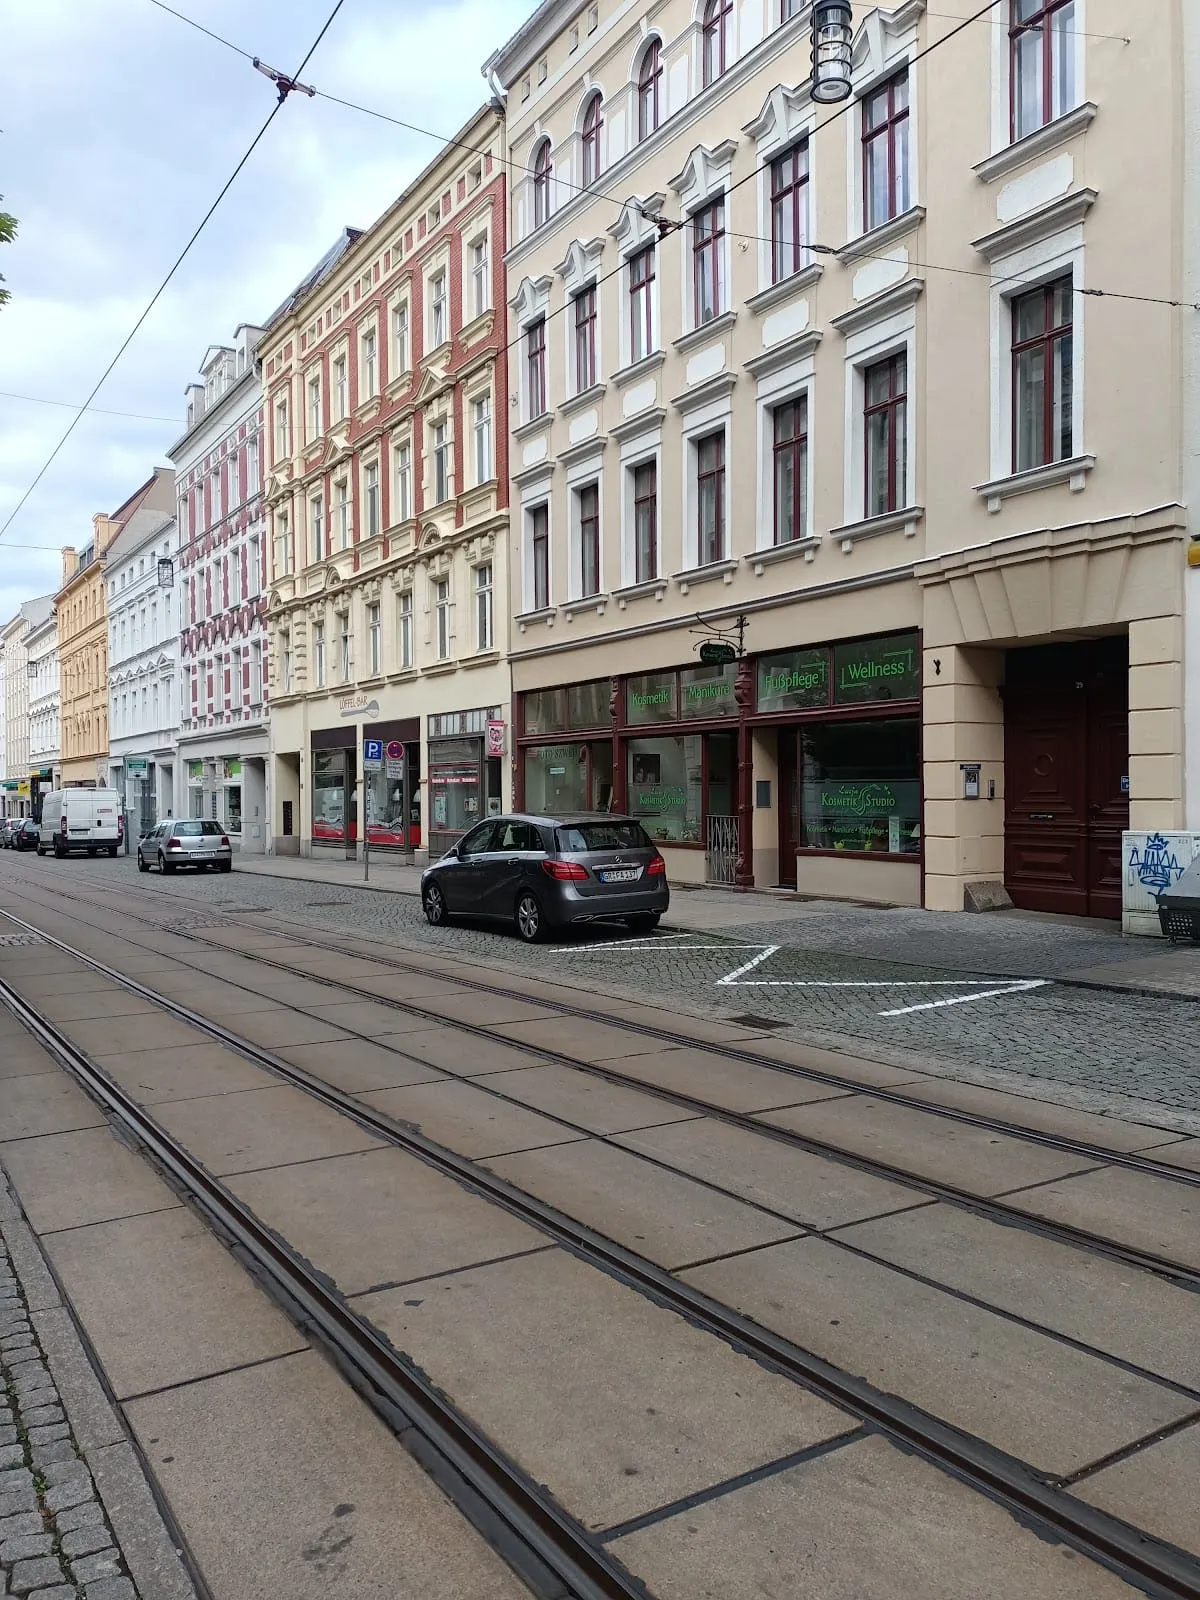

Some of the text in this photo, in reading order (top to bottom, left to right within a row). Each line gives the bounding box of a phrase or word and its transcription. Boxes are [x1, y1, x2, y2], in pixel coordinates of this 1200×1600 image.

[848, 661, 905, 680] Wellness
[766, 671, 819, 692] Fußpflege
[632, 689, 668, 705] Kosmetik
[368, 742, 379, 758] P
